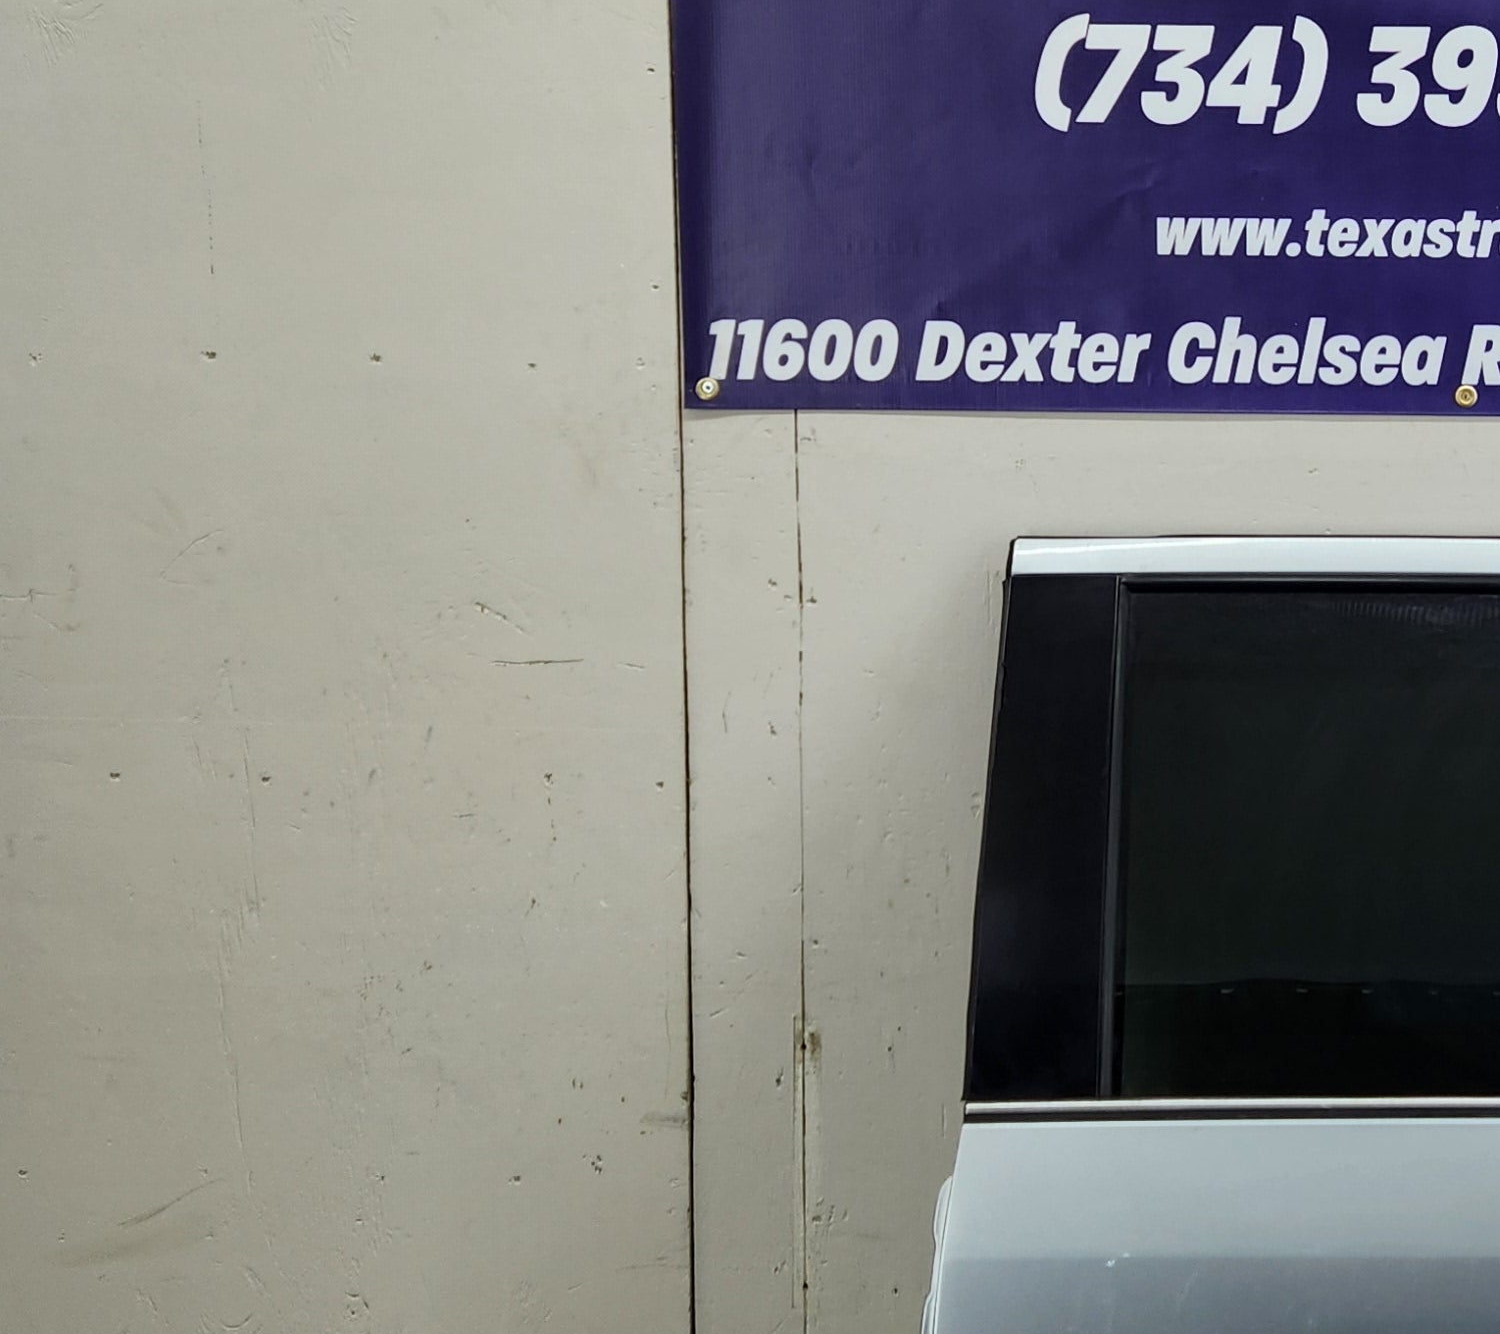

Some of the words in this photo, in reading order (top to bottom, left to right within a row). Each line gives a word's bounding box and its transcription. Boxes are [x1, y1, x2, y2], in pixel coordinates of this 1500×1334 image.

[1034, 13, 1329, 134] (734)
[708, 318, 899, 382] 11600
[915, 320, 1152, 383] Dexter
[1167, 316, 1447, 386] Chelsea
